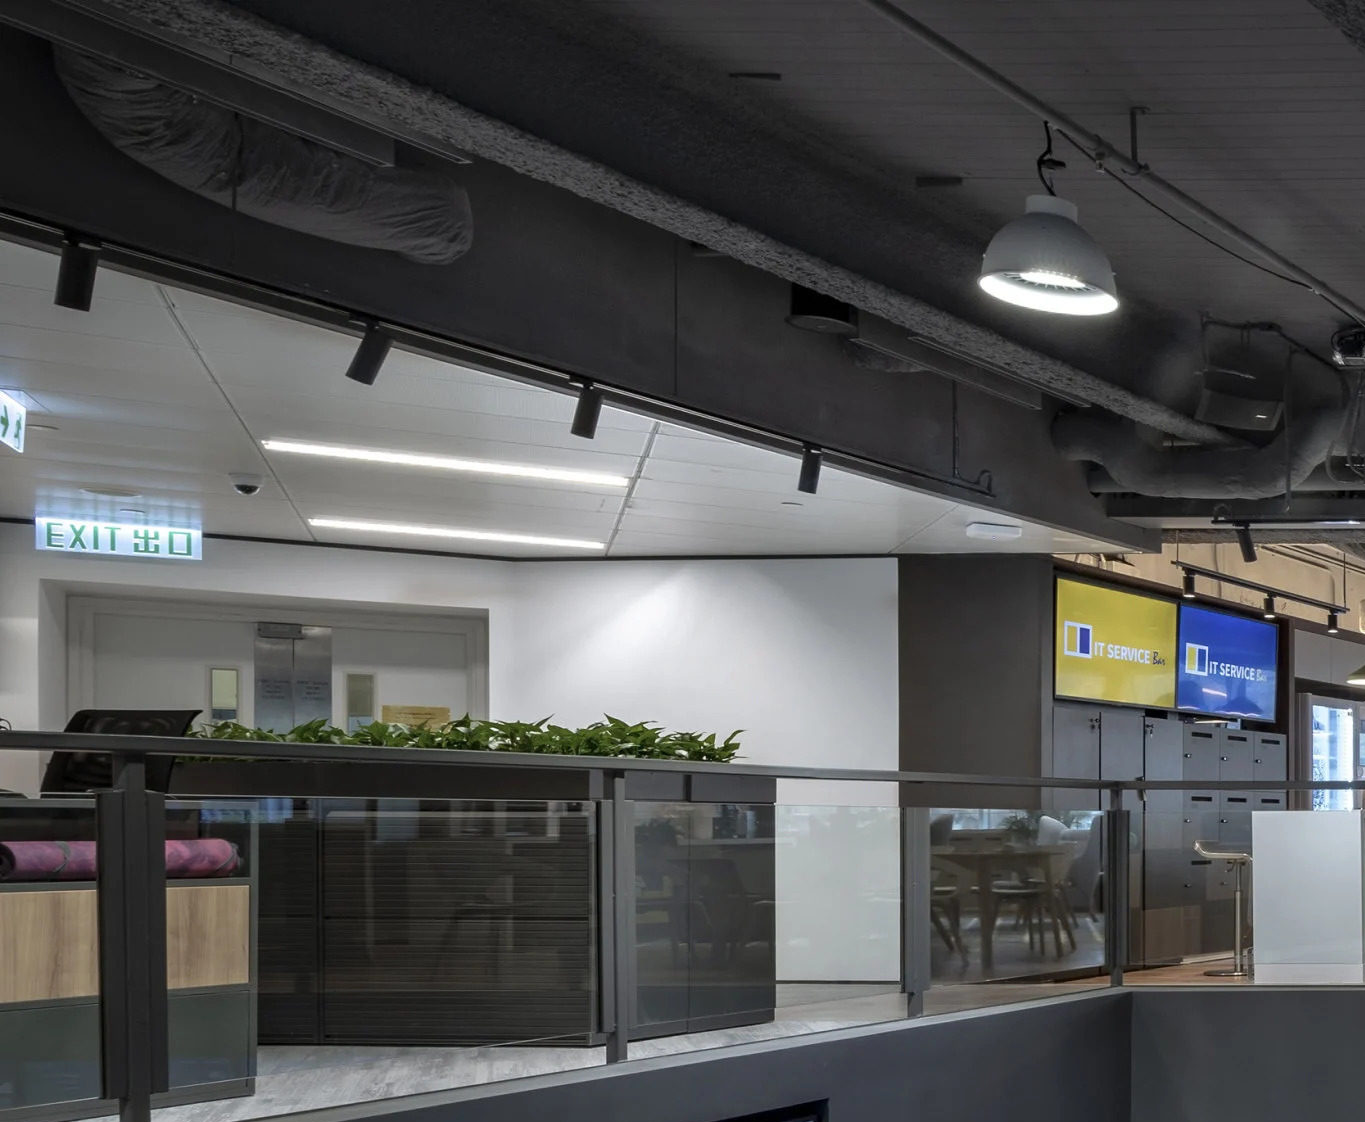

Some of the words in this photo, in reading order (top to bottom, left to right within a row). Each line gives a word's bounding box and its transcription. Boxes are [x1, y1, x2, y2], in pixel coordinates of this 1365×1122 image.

[46, 522, 122, 551] EXIT
[133, 529, 193, 557] 出口
[1094, 642, 1105, 657] IT
[1107, 644, 1150, 664] SERVICE
[1209, 661, 1217, 674] IT
[1220, 663, 1255, 681] SERVICE
